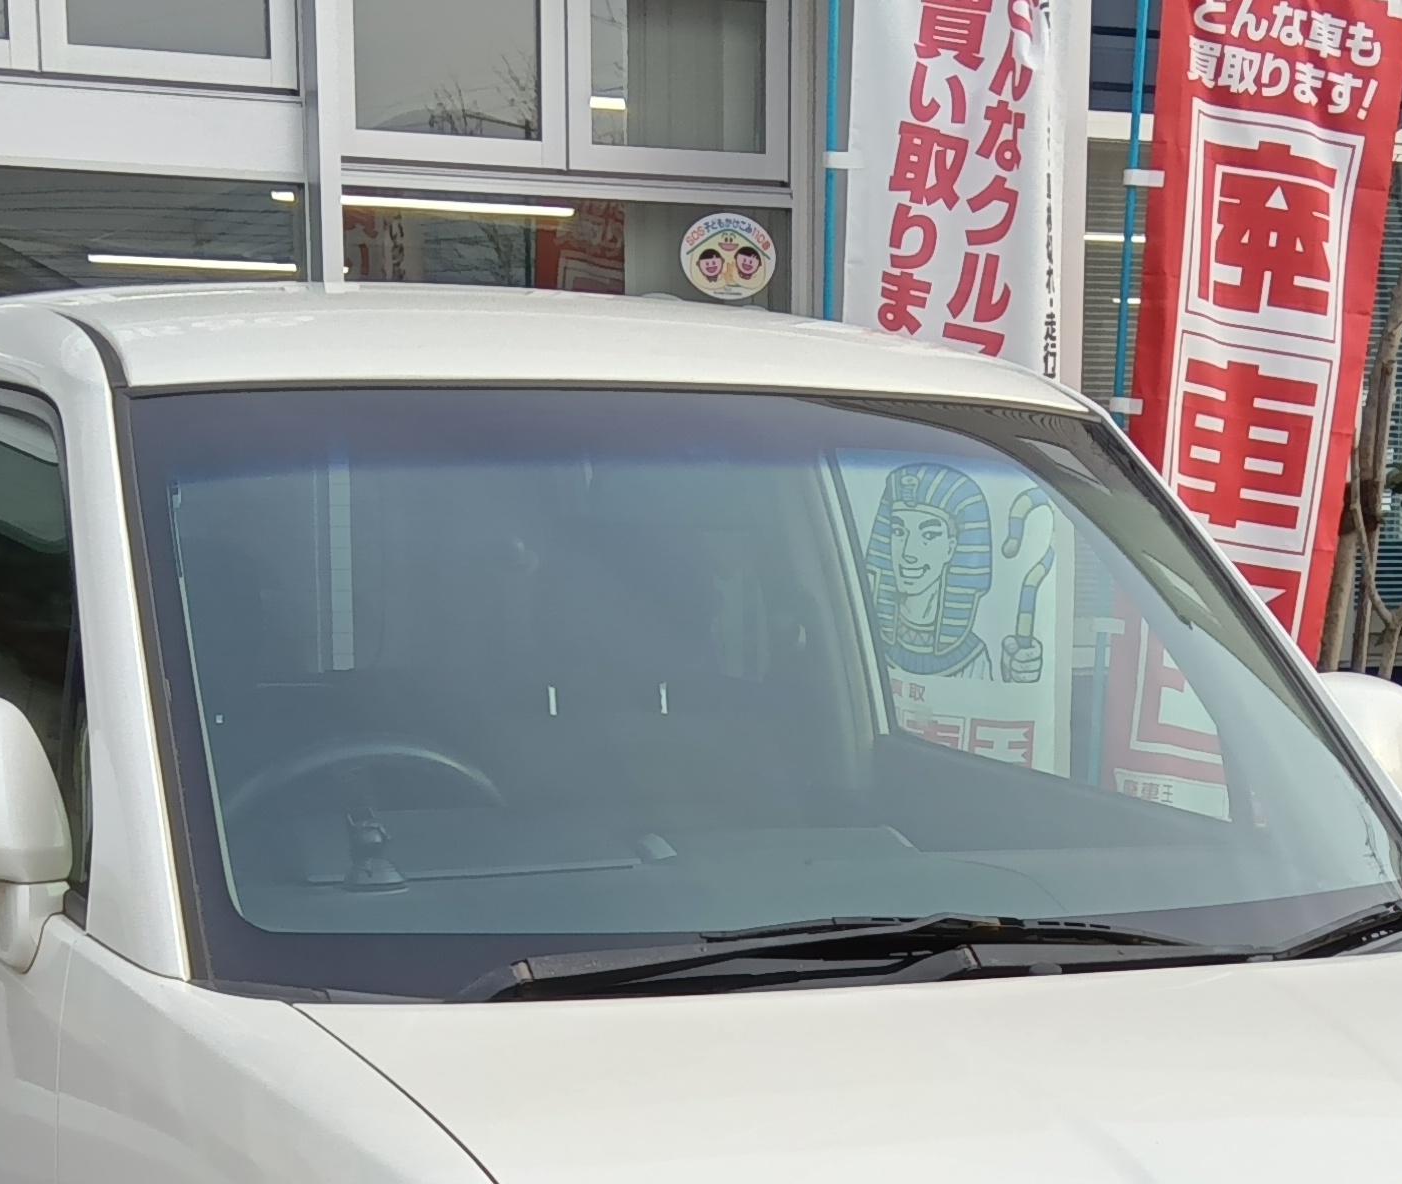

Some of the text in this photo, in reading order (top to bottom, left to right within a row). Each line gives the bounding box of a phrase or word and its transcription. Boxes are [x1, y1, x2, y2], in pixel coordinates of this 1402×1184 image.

[1187, 35, 1379, 121] 買取ります!
